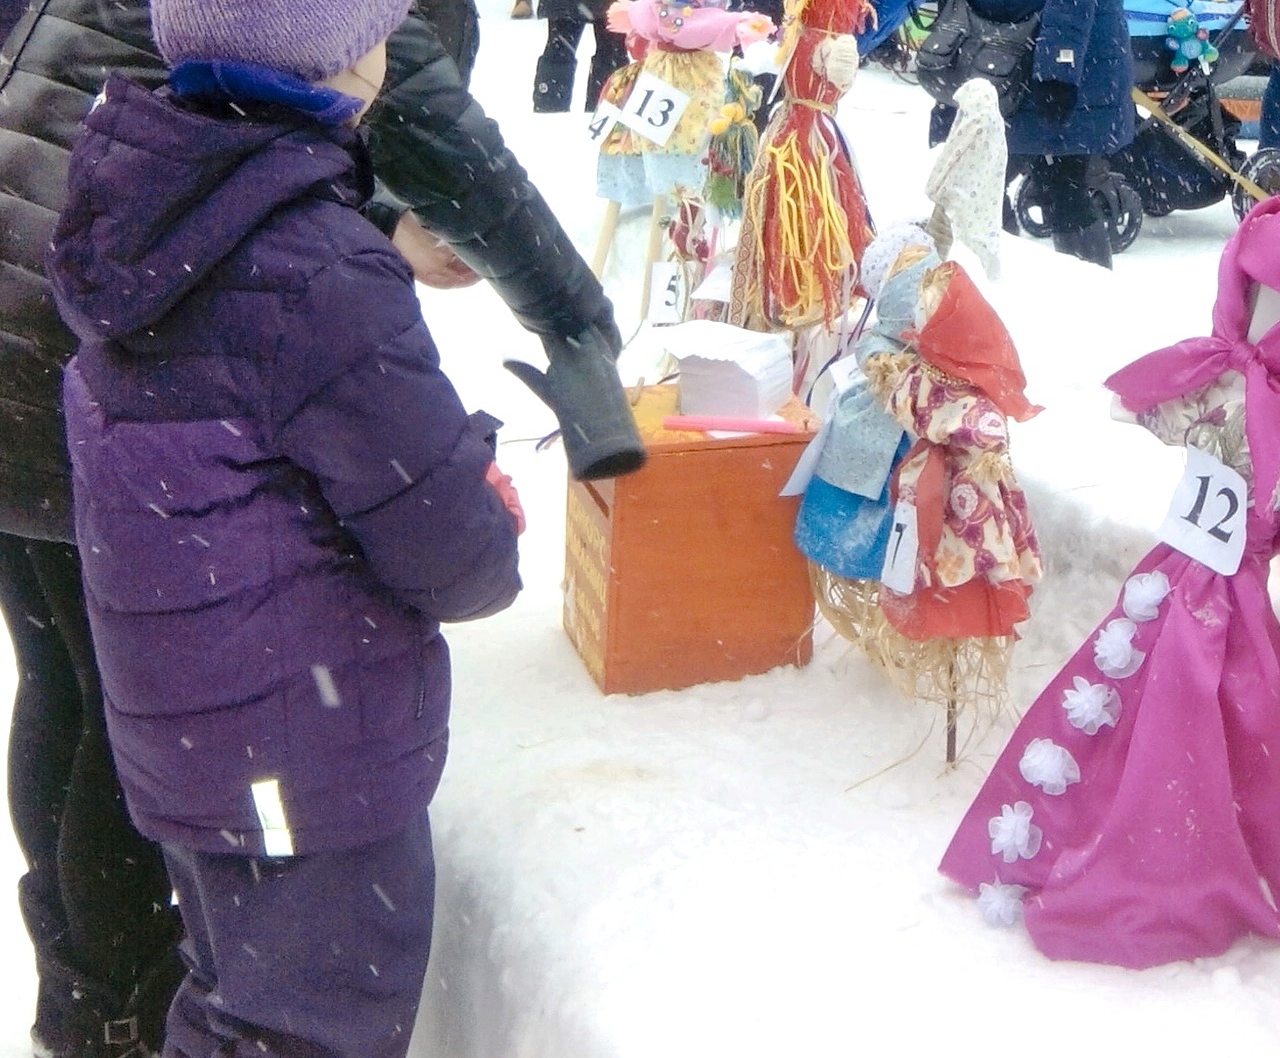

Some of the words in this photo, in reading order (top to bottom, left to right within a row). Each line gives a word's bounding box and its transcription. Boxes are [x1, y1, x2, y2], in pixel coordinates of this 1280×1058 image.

[633, 89, 675, 127] 13
[588, 115, 610, 140] 4
[665, 275, 681, 306] 5
[1180, 475, 1239, 544] 12
[891, 523, 907, 571] 7
